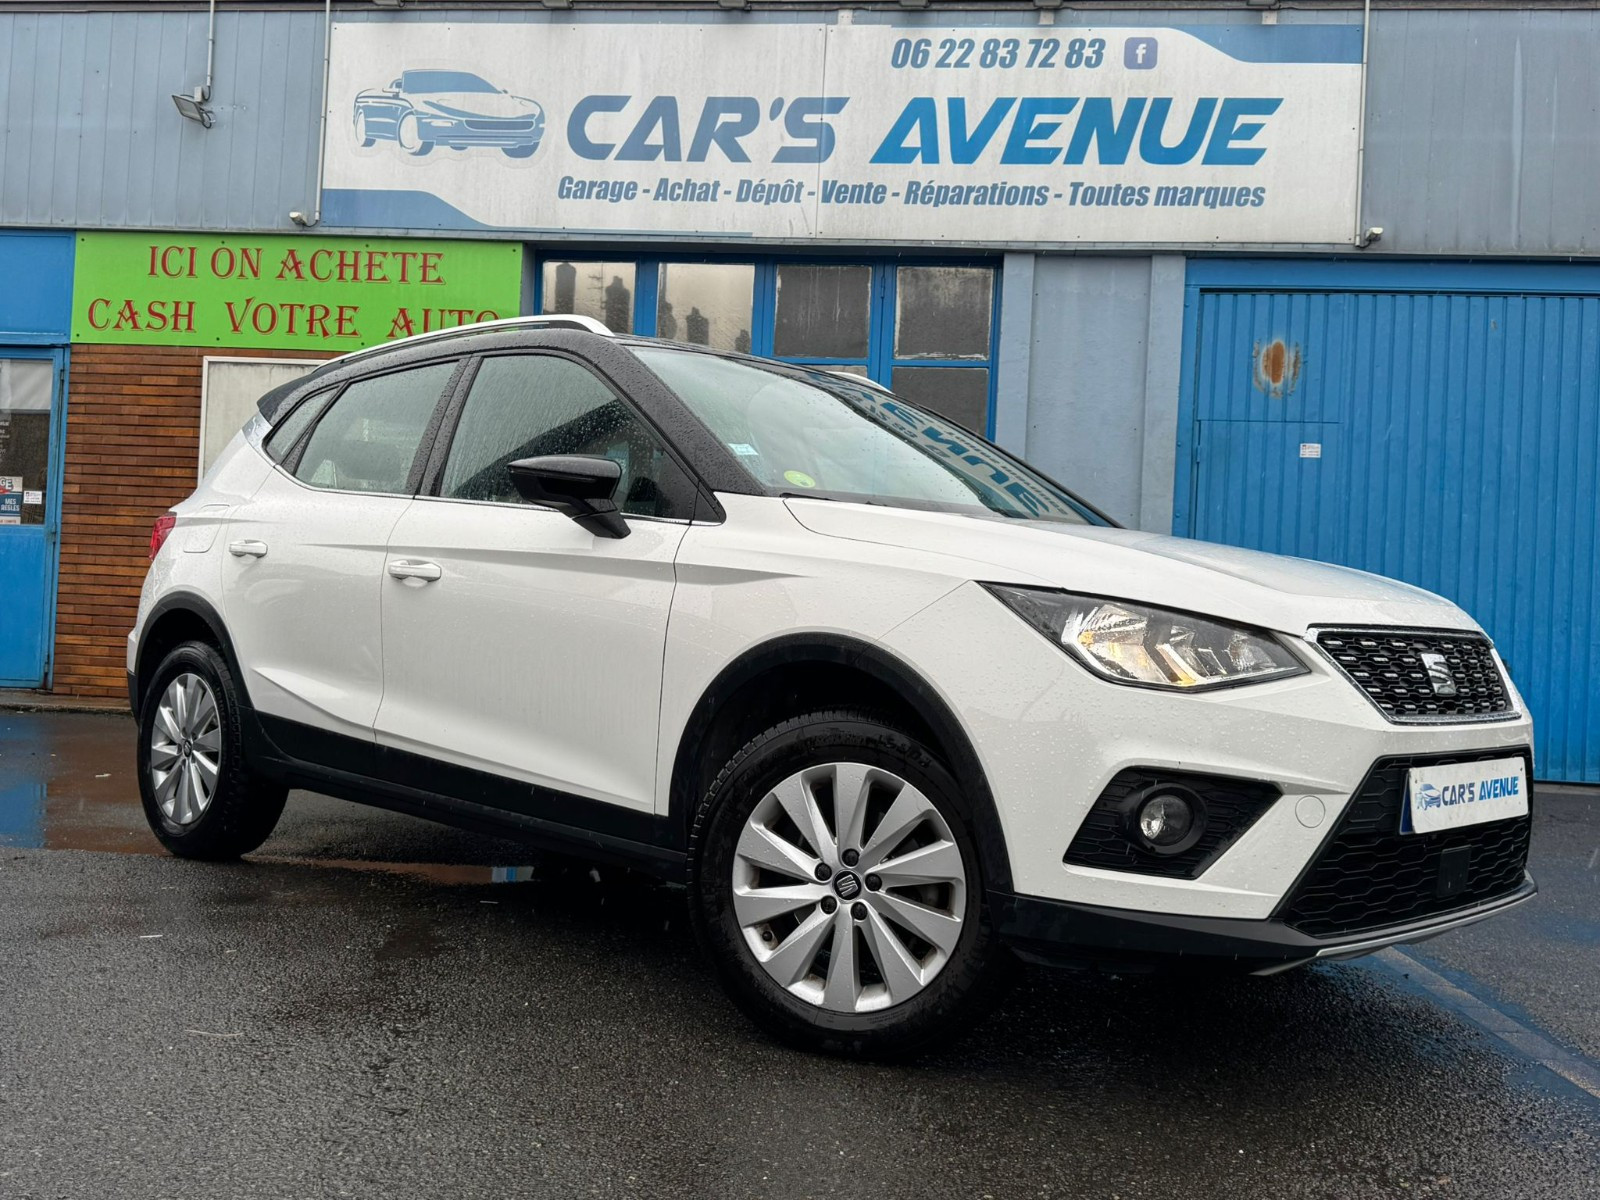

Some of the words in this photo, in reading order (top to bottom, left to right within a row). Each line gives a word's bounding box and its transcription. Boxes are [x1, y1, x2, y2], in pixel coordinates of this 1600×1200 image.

[891, 38, 932, 69] 06
[936, 38, 975, 69] 22
[980, 38, 1020, 69] 83
[1026, 38, 1061, 69] 72
[1065, 38, 1106, 69] 83
[567, 95, 850, 164] CAR'S
[869, 96, 1284, 166] AVENUE
[558, 176, 637, 203] Garage
[653, 178, 720, 202] Achat
[736, 178, 803, 206] Dépôt
[821, 181, 887, 205] Vente
[904, 179, 1049, 208] Réparations
[1068, 182, 1149, 207] Toutes
[1154, 186, 1266, 209] marques
[147, 245, 198, 279] ICI
[210, 247, 263, 280] ON
[275, 248, 446, 285] ACHETE
[87, 298, 196, 333] CASH
[224, 296, 361, 339] VOTRE
[1441, 782, 1476, 806] CAR'S
[1479, 776, 1519, 801] AVENUE
